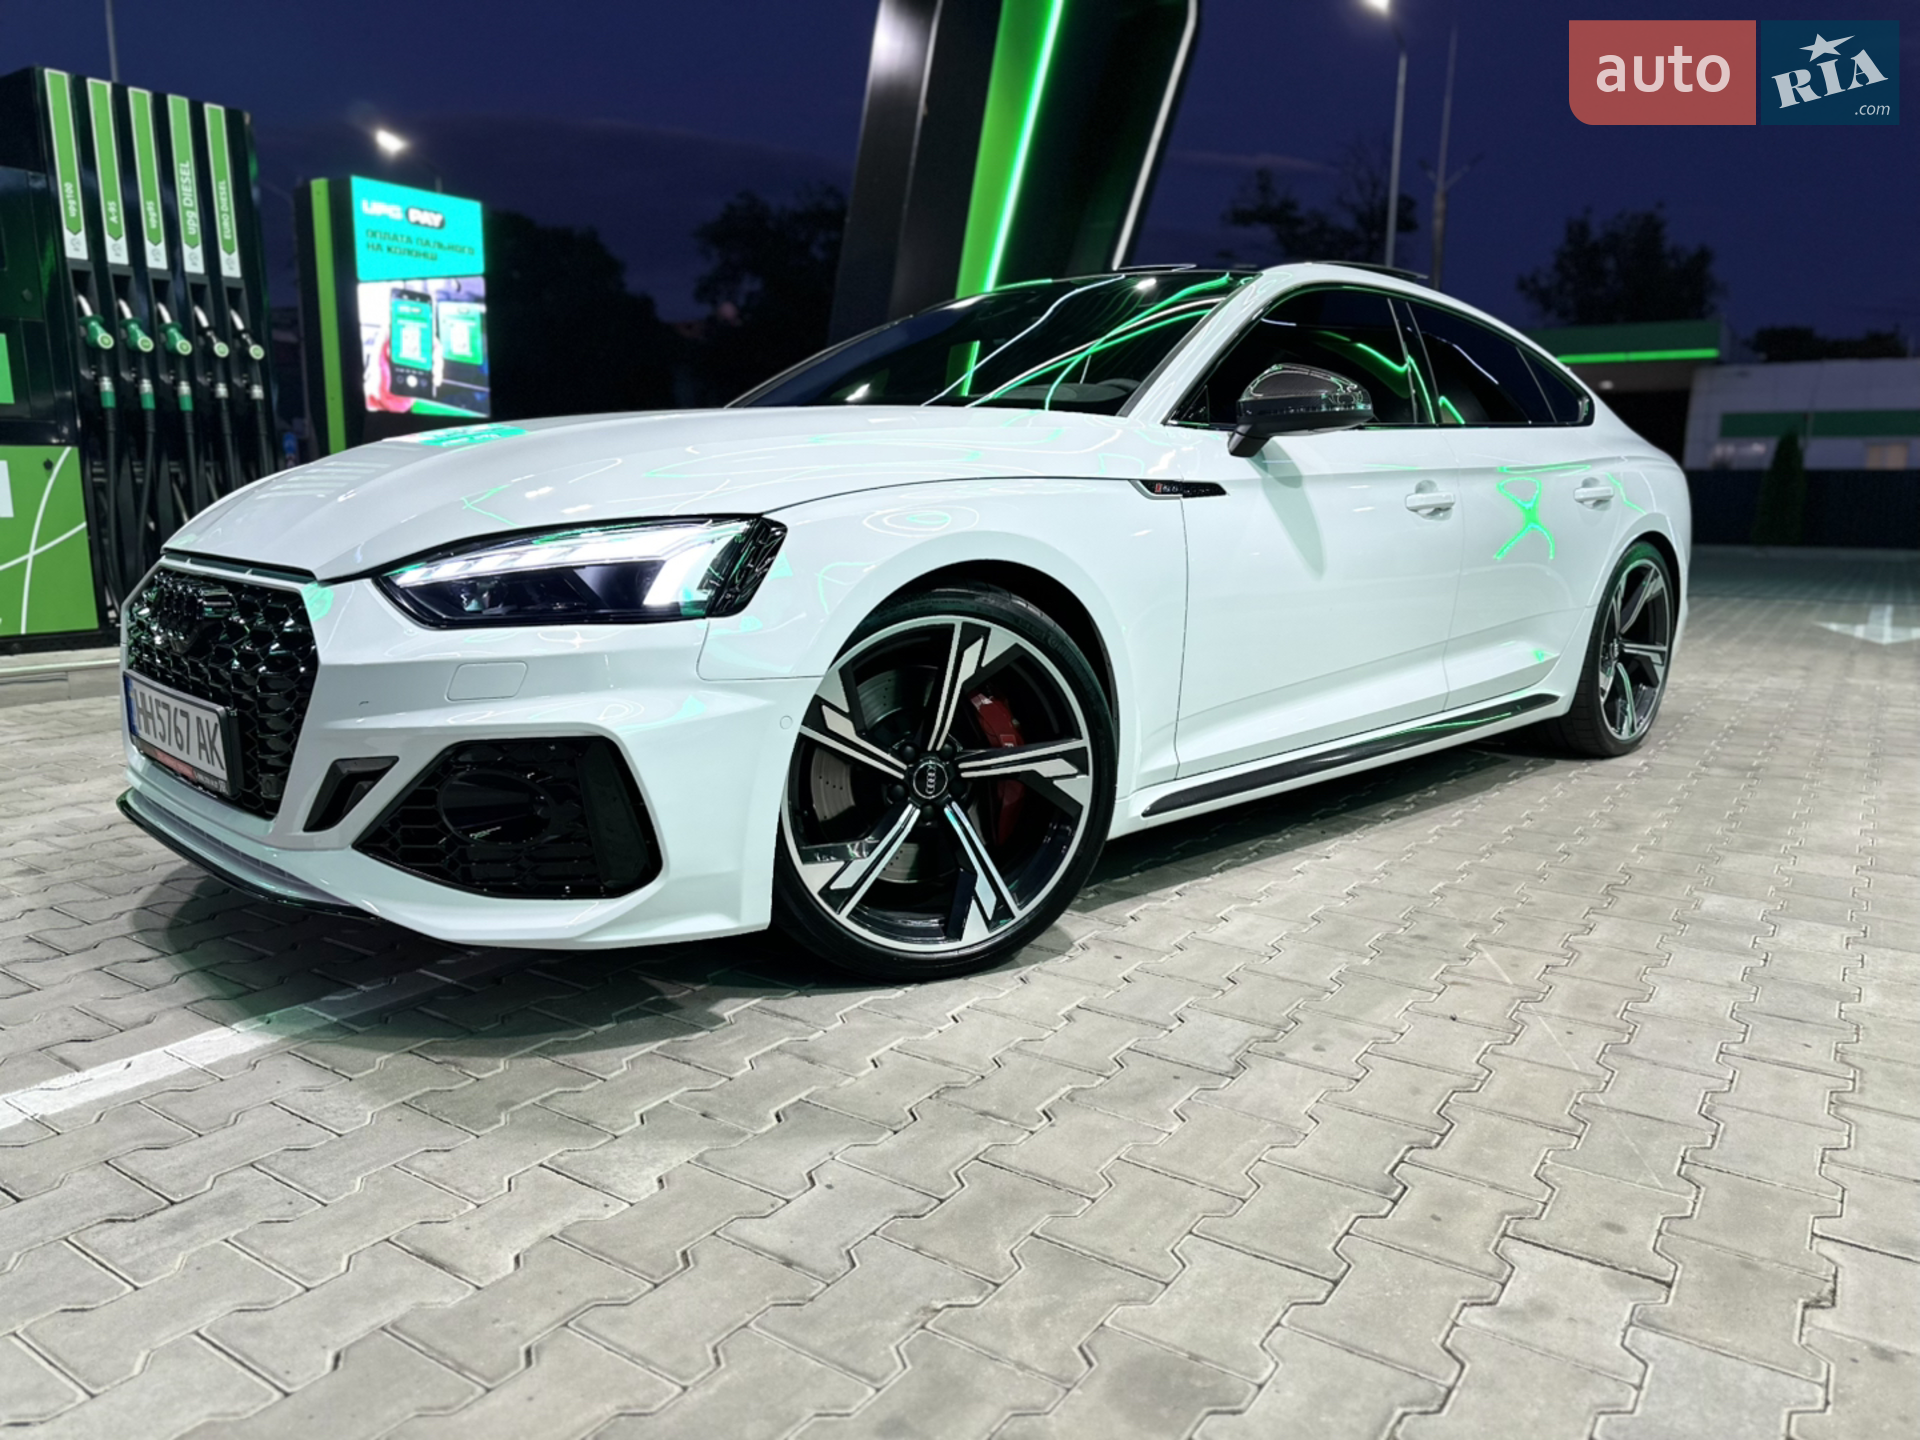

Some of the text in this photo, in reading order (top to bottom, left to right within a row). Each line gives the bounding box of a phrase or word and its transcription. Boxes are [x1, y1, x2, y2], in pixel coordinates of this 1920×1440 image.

[64, 182, 77, 218] upg100
[107, 201, 118, 225] A-95
[146, 201, 158, 229] upg95
[179, 160, 198, 235] upg DIESEL
[218, 180, 232, 240] EURO DIESEL
